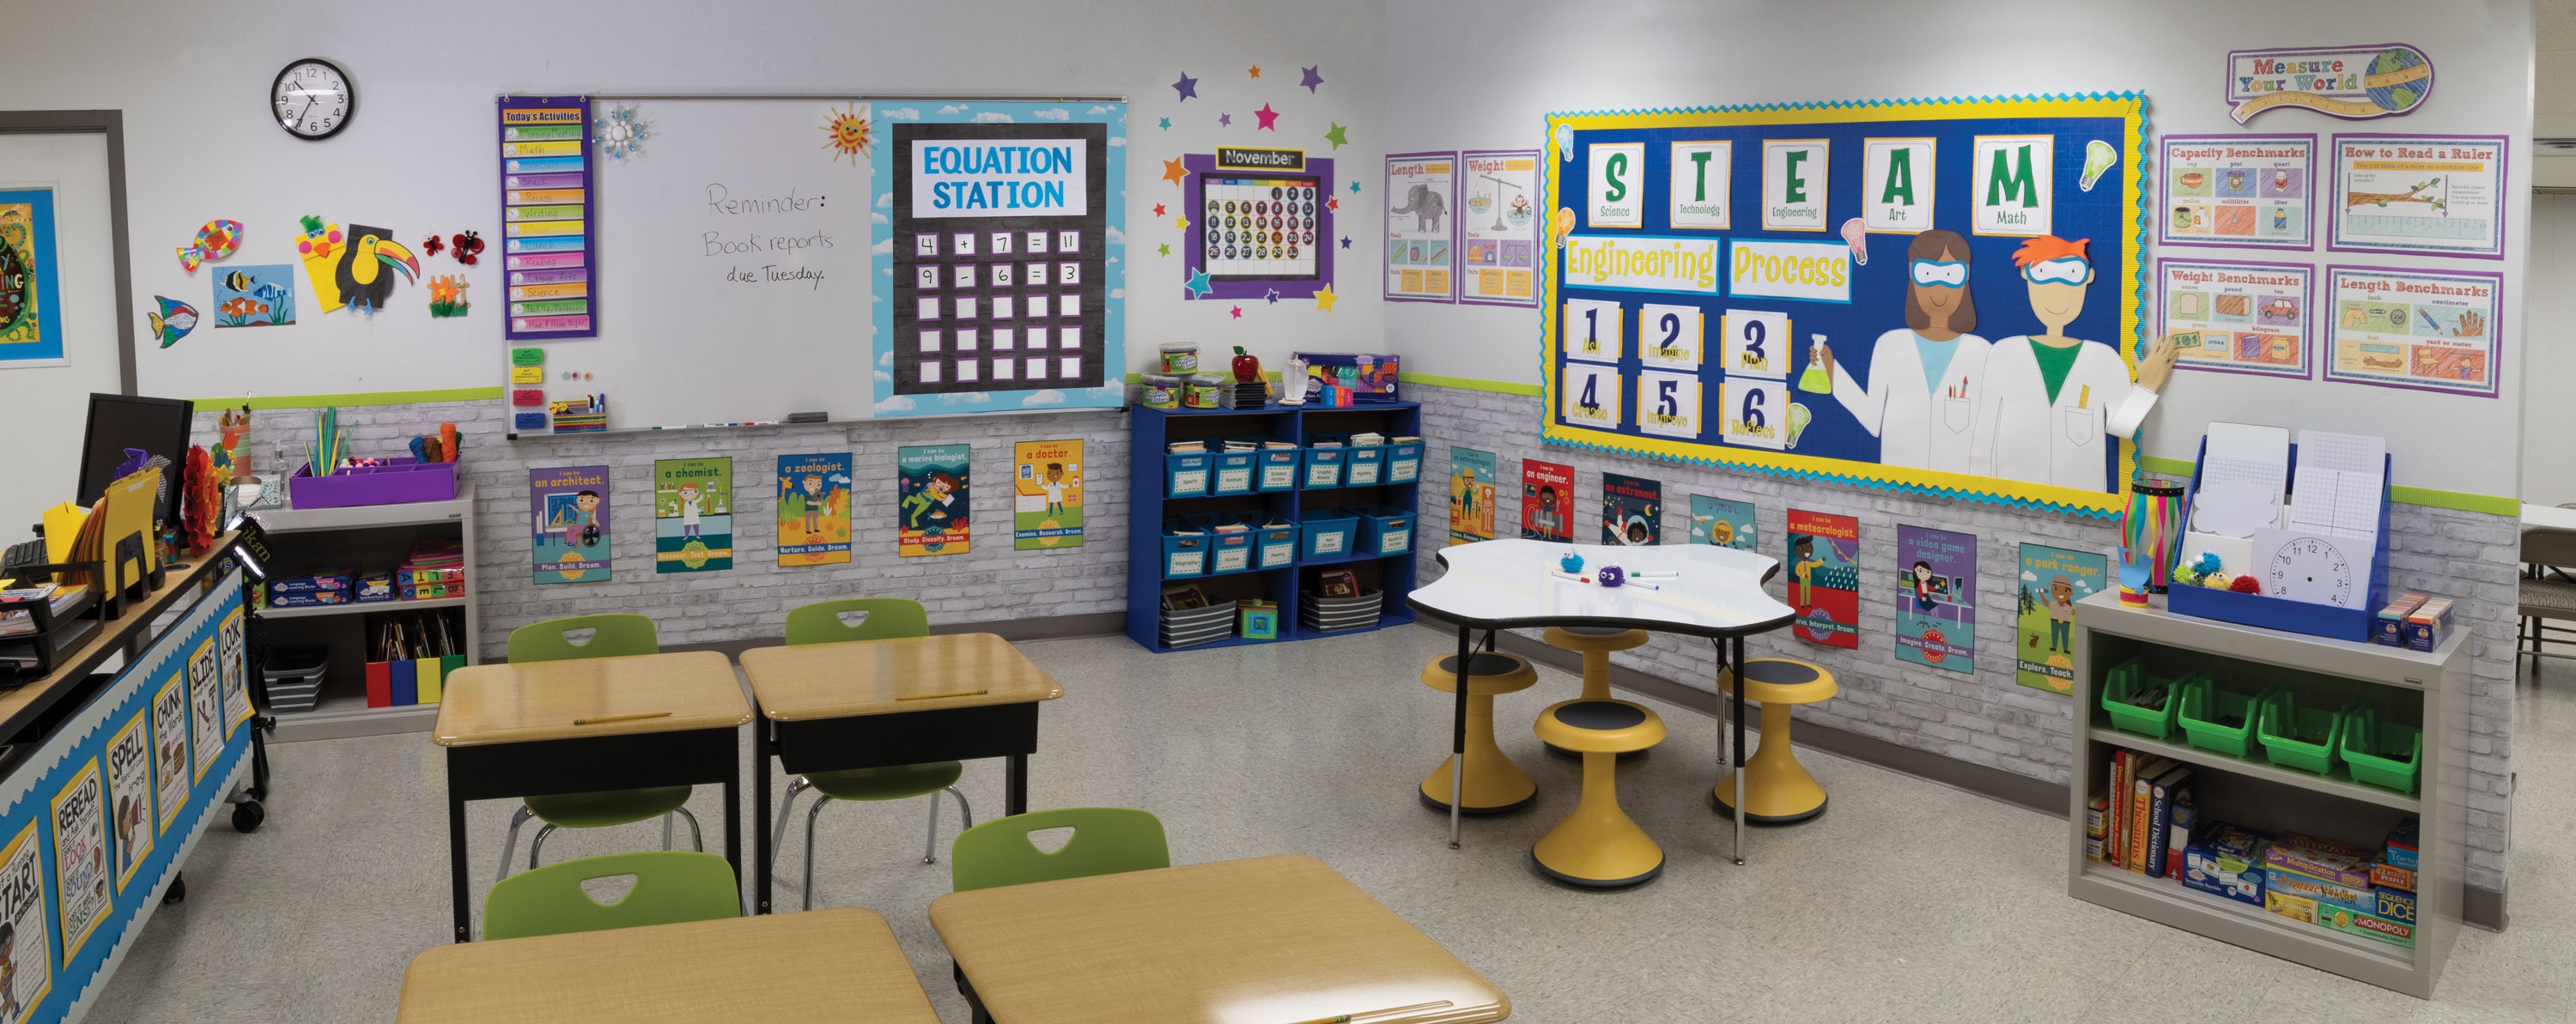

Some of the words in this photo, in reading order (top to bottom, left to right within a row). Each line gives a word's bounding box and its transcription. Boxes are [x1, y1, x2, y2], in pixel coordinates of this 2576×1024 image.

[306, 68, 317, 78] 12
[2253, 59, 2343, 75] Measure
[2239, 76, 2286, 92] Your
[2294, 74, 2358, 91] World
[337, 94, 344, 104] 3
[506, 112, 538, 122] Today's
[539, 112, 580, 121] Activities
[310, 122, 318, 131] 6
[519, 145, 544, 155] Math
[1225, 149, 1295, 166] November
[2171, 148, 2224, 161] Capacity
[2226, 147, 2306, 158] Benchmarks
[2345, 147, 2375, 158] How
[2379, 148, 2393, 158] to
[2397, 148, 2433, 159] Read
[2438, 150, 2446, 159] a
[2451, 148, 2493, 160] Ruler
[924, 146, 1072, 175] EQUATION
[1468, 160, 1504, 174] Weight
[1391, 164, 1425, 178] Length
[1606, 153, 1627, 203] S
[1691, 151, 1712, 202] T
[1786, 150, 1808, 203] E
[1881, 148, 1915, 206] A
[1986, 144, 2039, 208] M
[526, 192, 553, 202] Recess
[706, 183, 826, 215] Reminder:
[933, 180, 1065, 209] STATION
[523, 209, 558, 219] Writing
[1601, 205, 1630, 217] Science
[1680, 203, 1720, 216] Technology
[1772, 206, 1817, 220] Engineering
[1888, 209, 1907, 221] Art
[1996, 211, 2027, 225] Math
[526, 241, 556, 251] Lunch
[702, 231, 761, 258] Book
[769, 229, 835, 257] reports
[922, 238, 933, 253] 4
[997, 237, 1007, 251] 7
[1063, 234, 1073, 248] 11
[526, 258, 556, 268] Reading
[1567, 240, 1714, 288] Engineering
[1734, 246, 1846, 287] Process
[726, 265, 757, 283] due
[761, 264, 825, 290] Tuesday.
[922, 269, 933, 284] 9
[999, 270, 1009, 282] 6
[1066, 266, 1075, 279] 3
[2172, 270, 2214, 284] Weight
[2217, 272, 2300, 287] Benchmarks
[527, 288, 560, 297] Science
[2340, 277, 2391, 294] Length
[2396, 281, 2488, 298] Benchmarks
[1586, 307, 1598, 350] 1
[1660, 312, 1680, 357] 2
[1582, 338, 1601, 355] Ask
[1743, 319, 1766, 365] 3
[1648, 343, 1690, 363] Imagine
[1741, 352, 1768, 372] Plan
[1580, 373, 1600, 415] 4
[1657, 380, 1678, 423] 5
[1571, 402, 1608, 421] Create
[1646, 409, 1688, 428] Improve
[1742, 388, 1765, 433] 6
[1731, 419, 1776, 439] Reflect
[934, 452, 967, 462] biologist.
[1036, 450, 1071, 458] doctor.
[676, 467, 722, 478] chemist.
[794, 462, 845, 474] zoologist.
[550, 475, 605, 487] architect.
[1526, 470, 1535, 478] an
[1536, 471, 1569, 484] engineer.
[1605, 483, 1615, 493] an
[1617, 485, 1659, 500] astronaut.
[1796, 523, 1856, 538] meteorologist.
[242, 525, 271, 563] ikan
[1916, 538, 1939, 549] video
[1941, 542, 1965, 554] game
[2307, 545, 2318, 554] 12
[1916, 548, 1956, 563] designer.
[2282, 556, 2291, 565] 10
[2026, 557, 2032, 566] a
[2035, 558, 2058, 570] park
[2062, 563, 2101, 577] ranger.
[1809, 620, 1836, 631] Interpret.
[1837, 624, 1856, 633] Dream.
[221, 617, 240, 657] LOOK
[1899, 636, 1923, 648] Imagine.
[1924, 640, 1947, 652] Create.
[1947, 645, 1969, 656] Dream.
[191, 648, 214, 691] SLIDE
[2019, 660, 2048, 674] Explore.
[2050, 666, 2073, 679] Teach.
[157, 686, 181, 729] CHUNK
[159, 730, 167, 745] the
[167, 711, 183, 731] Words
[112, 729, 143, 780] SPELL
[59, 777, 97, 836] REREAD
[2153, 799, 2162, 827] School
[2132, 797, 2147, 860] Thesaurus
[64, 834, 88, 872] LOOK
[2148, 827, 2161, 870] Dictionary
[2287, 857, 2336, 877] Multiplication
[2376, 868, 2385, 876] 42
[2386, 870, 2406, 879] PIECE
[66, 861, 93, 904] SOUND
[2342, 874, 2365, 887] Bingo
[2381, 876, 2405, 885] PUZZLE
[2378, 891, 2415, 906] SEQUENCE
[2378, 900, 2416, 921] DICE
[2357, 915, 2410, 936] MONOPOLY
